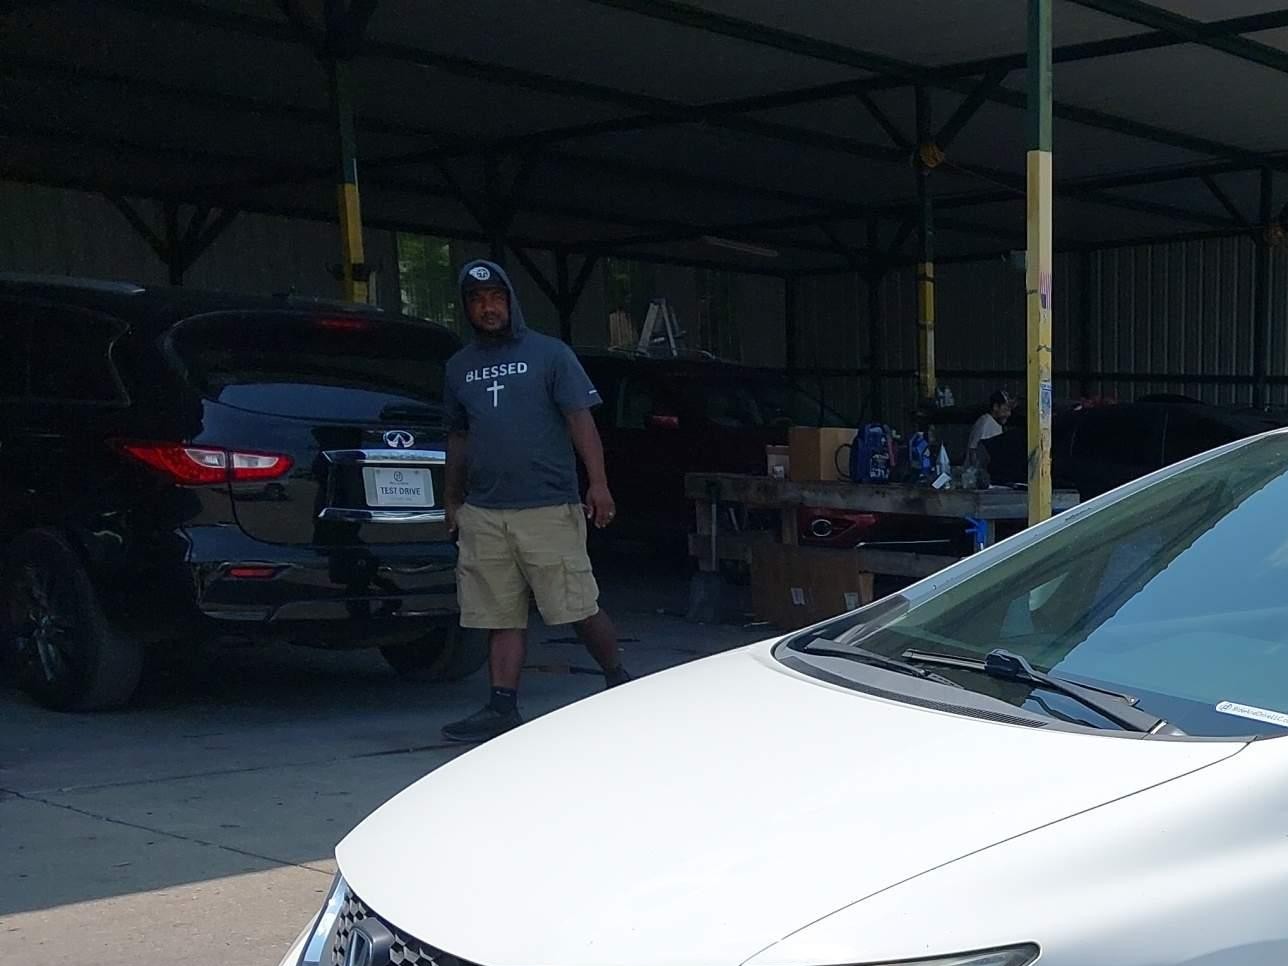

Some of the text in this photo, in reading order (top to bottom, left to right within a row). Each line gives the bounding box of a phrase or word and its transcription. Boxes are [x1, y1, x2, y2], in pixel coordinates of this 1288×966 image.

[465, 362, 528, 383] BLESSED
[380, 486, 421, 496] TEST DRIVE
